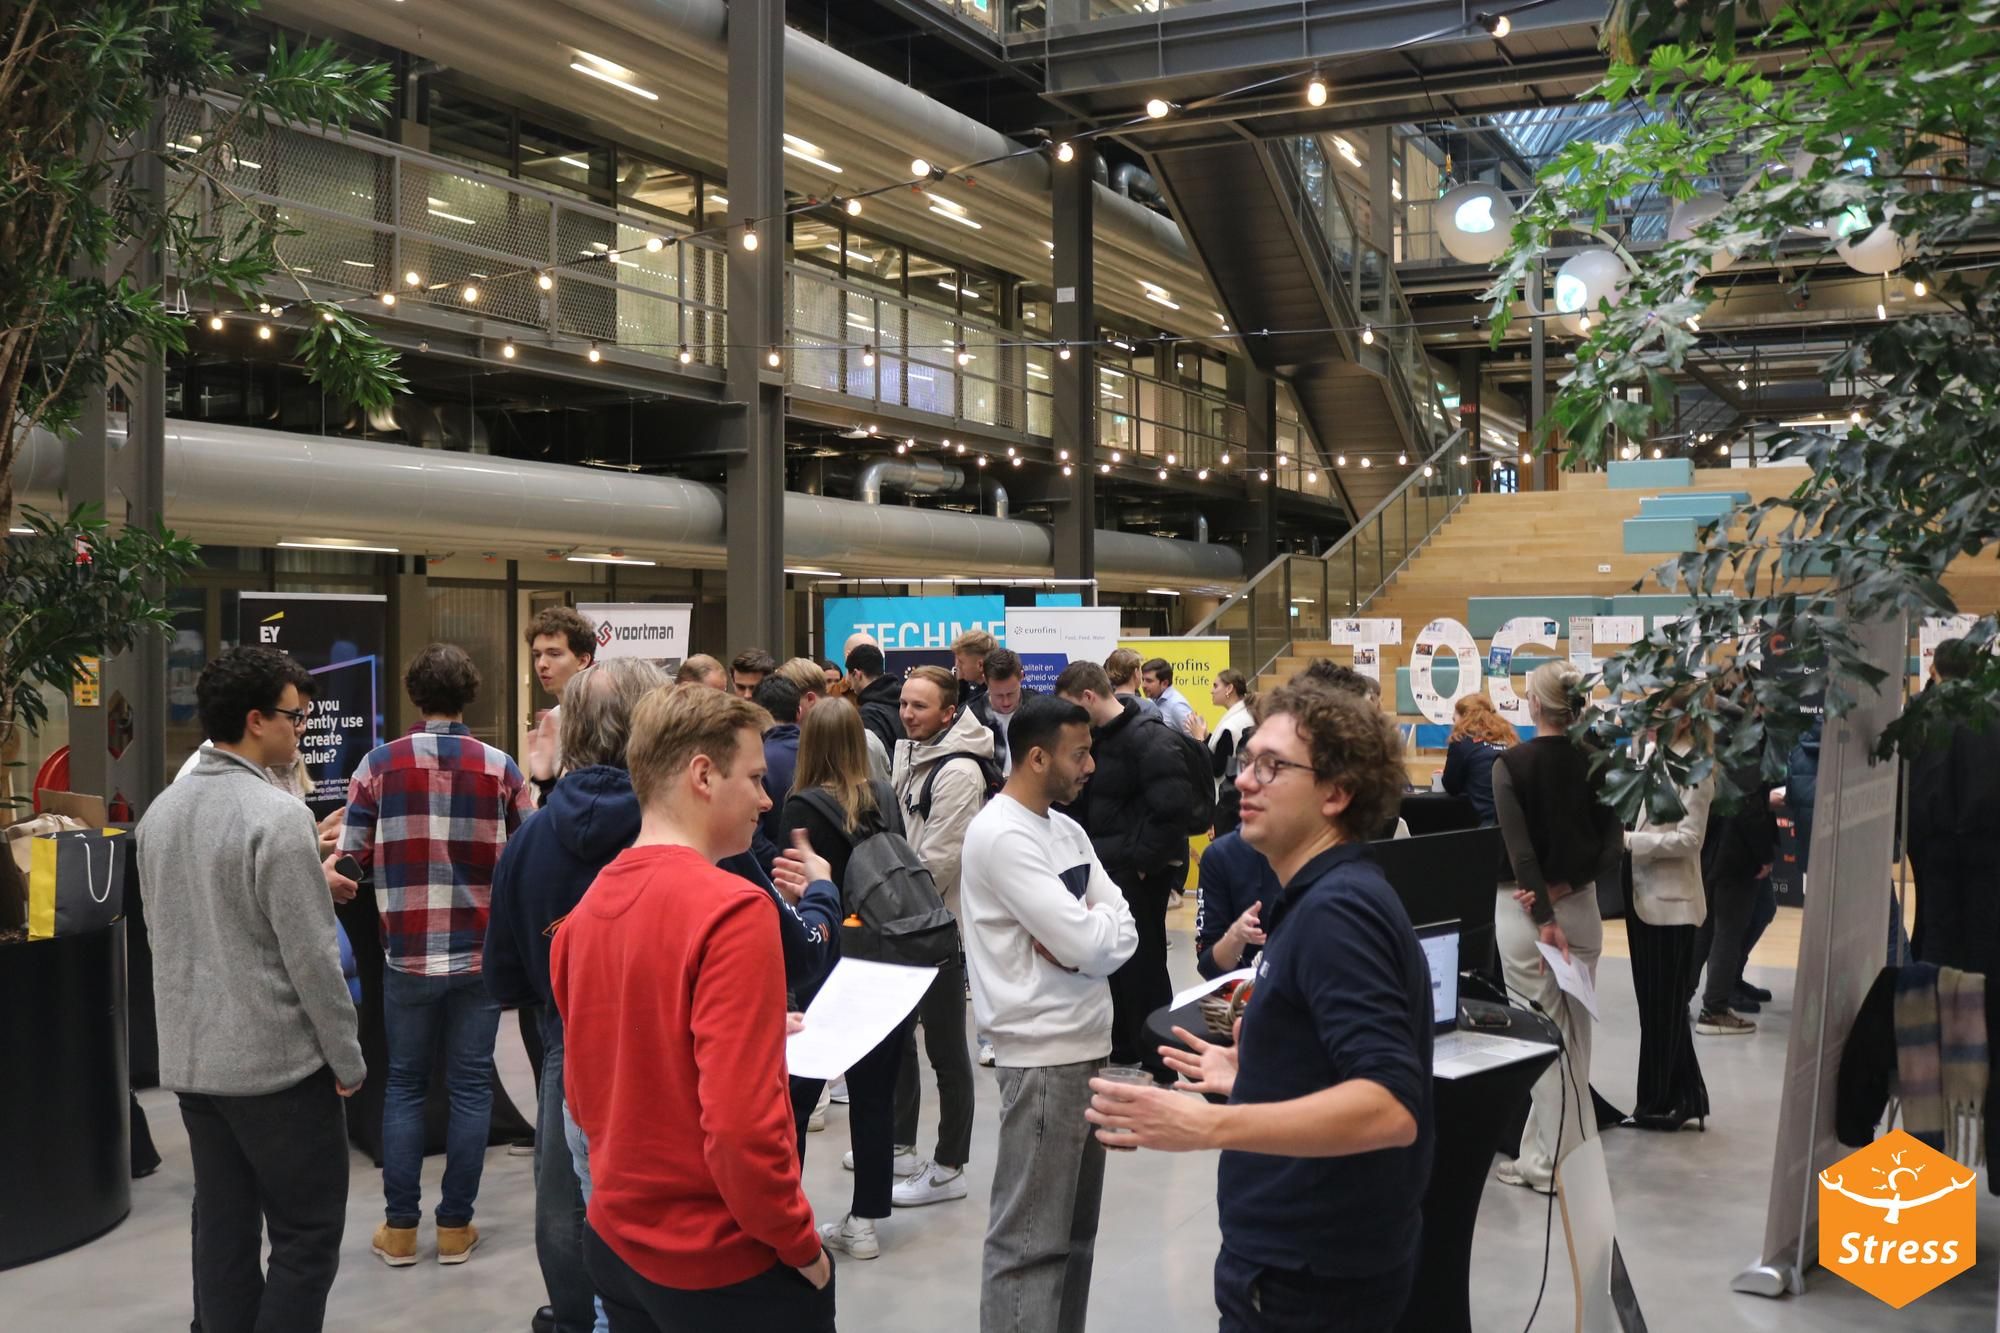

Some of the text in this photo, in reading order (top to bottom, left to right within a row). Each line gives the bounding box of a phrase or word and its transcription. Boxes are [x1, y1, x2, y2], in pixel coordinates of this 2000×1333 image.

[259, 626, 281, 643] EY
[614, 623, 675, 641] voortman
[1024, 626, 1057, 634] eurofins
[1172, 658, 1210, 672] rofins
[1175, 675, 1210, 686] for Life
[317, 700, 340, 715] you
[307, 715, 364, 731] ently use
[303, 732, 343, 747] create
